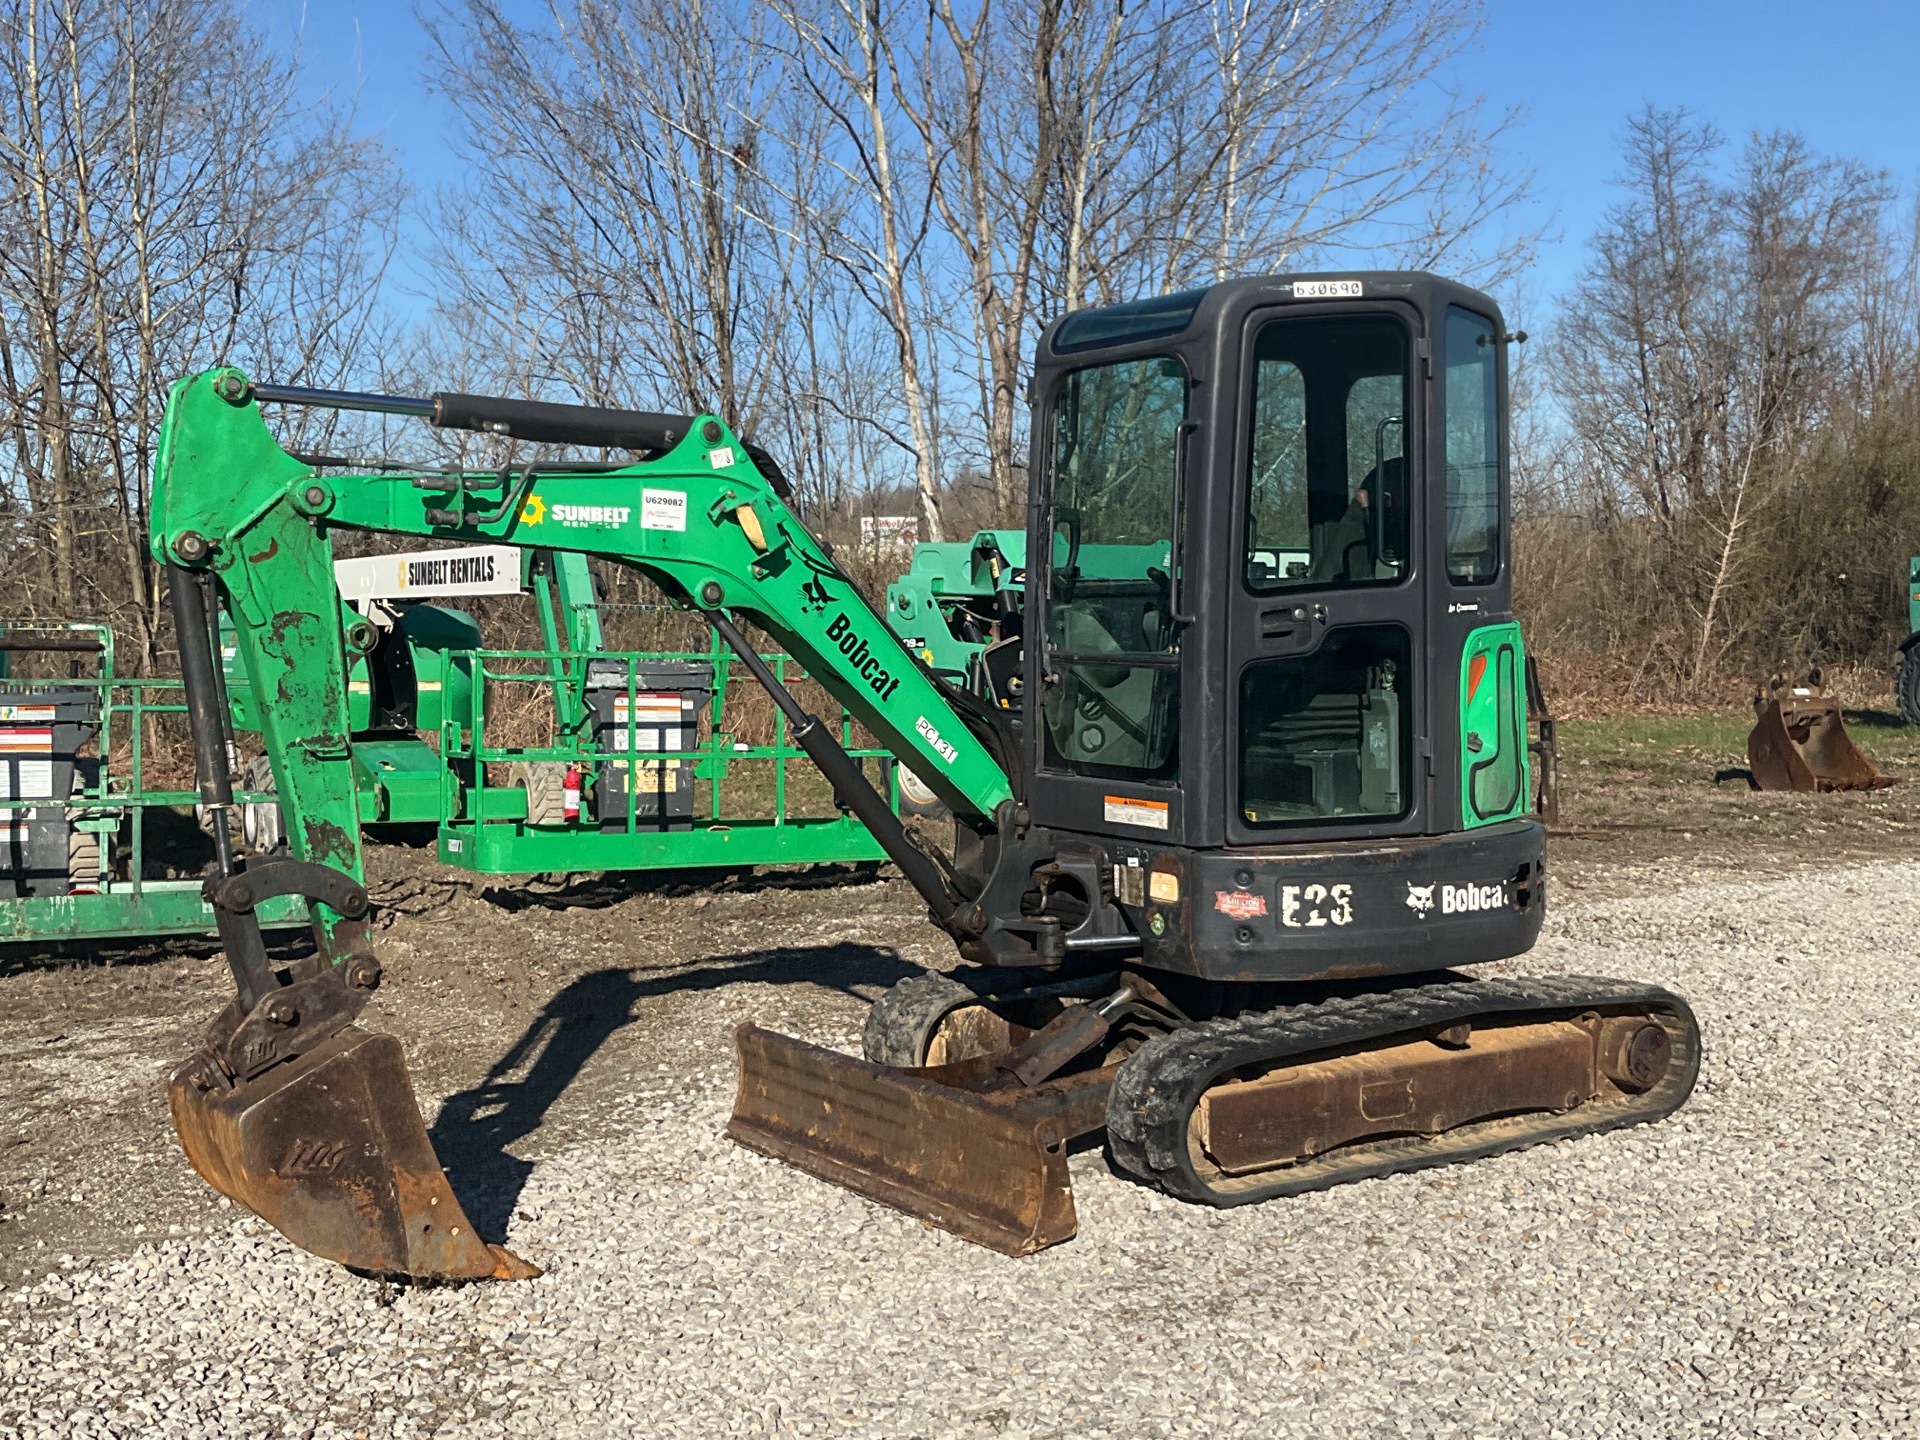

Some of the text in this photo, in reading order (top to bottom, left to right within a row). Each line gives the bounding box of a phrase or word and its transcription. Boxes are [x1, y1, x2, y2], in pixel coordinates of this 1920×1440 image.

[1296, 282, 1360, 296] 630690
[645, 496, 684, 507] U629082
[551, 504, 631, 523] SUNBELT
[563, 520, 620, 529] RENS
[408, 555, 494, 586] SUNBELT RENTALS
[825, 611, 901, 702] Bobcat
